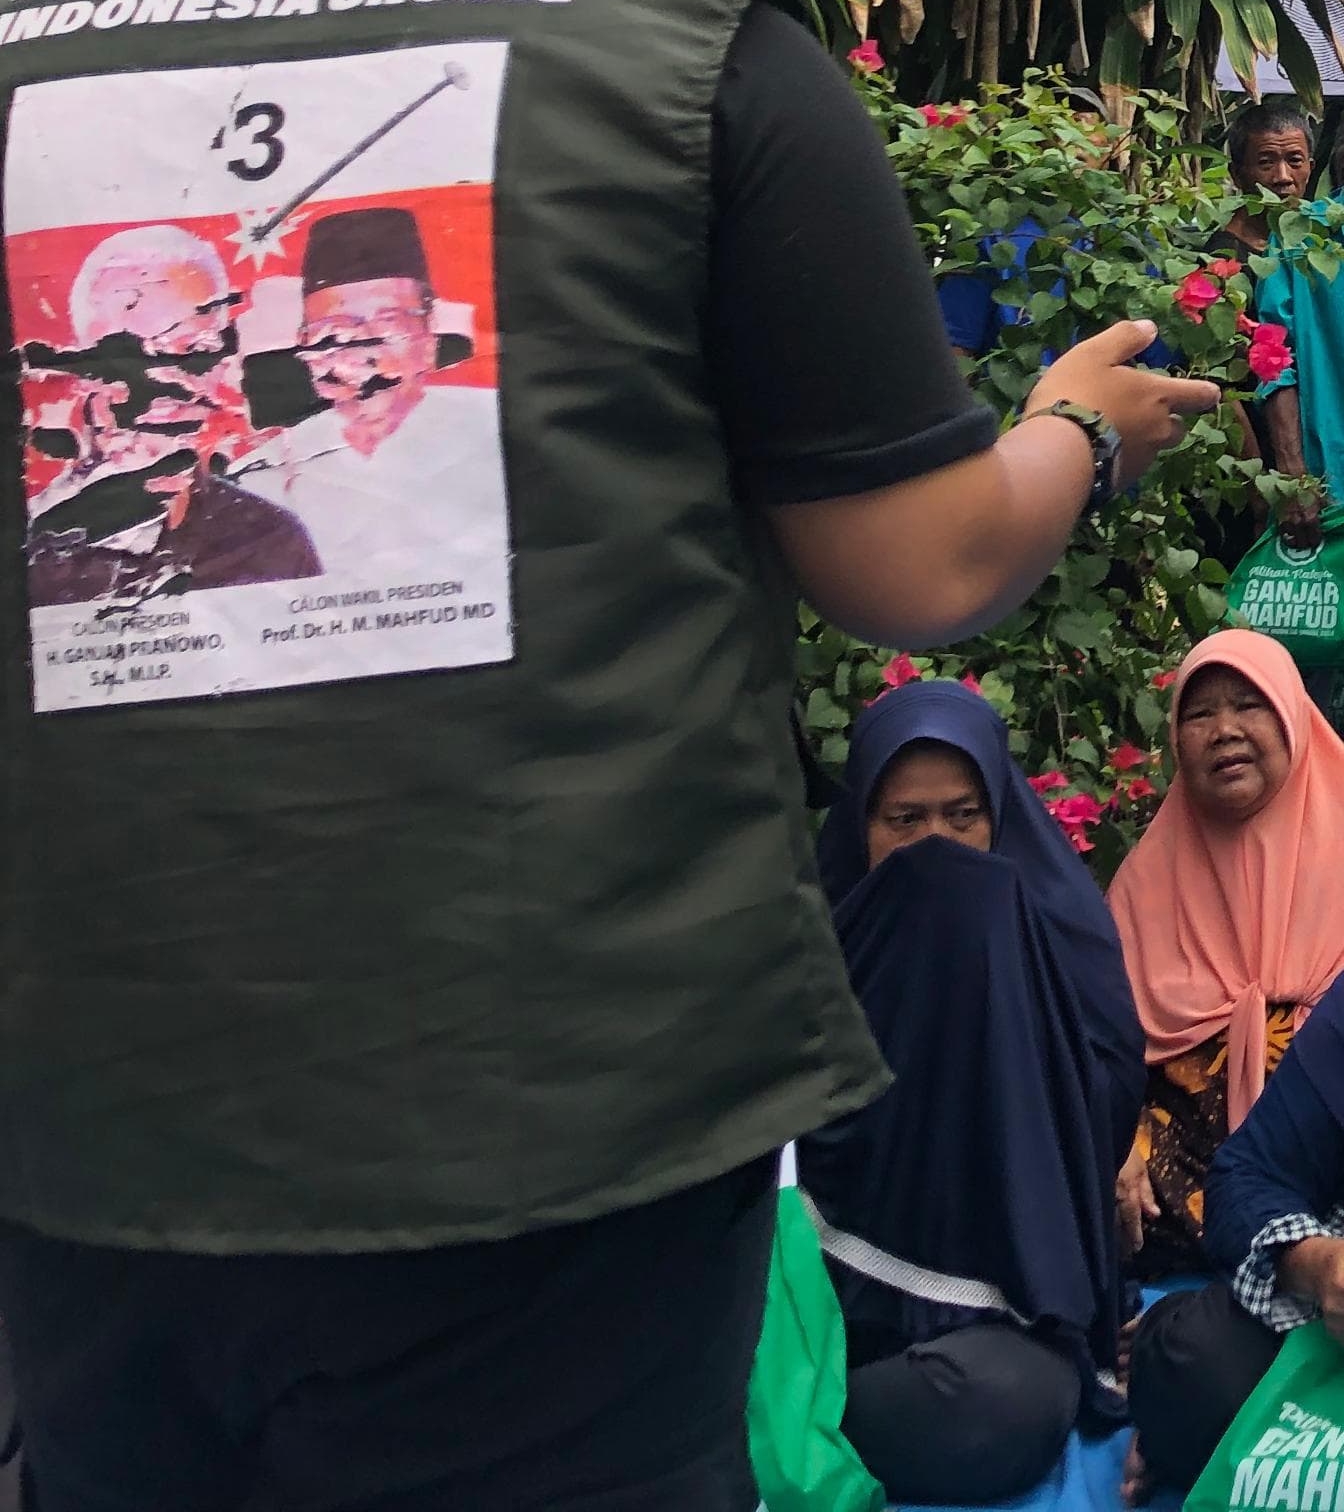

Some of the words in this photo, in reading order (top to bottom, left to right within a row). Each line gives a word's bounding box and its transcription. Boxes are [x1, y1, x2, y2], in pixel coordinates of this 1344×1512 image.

[226, 102, 287, 182] 3
[387, 581, 464, 603] PRESIDEN
[1243, 578, 1340, 605] GANJAR
[261, 623, 300, 645] Prof.
[303, 622, 326, 640] Dr.
[329, 619, 347, 636] H.
[352, 616, 372, 632] M.
[376, 606, 458, 630] MAHFUD
[463, 602, 496, 620] MD
[1240, 602, 1339, 629] MAHFUD
